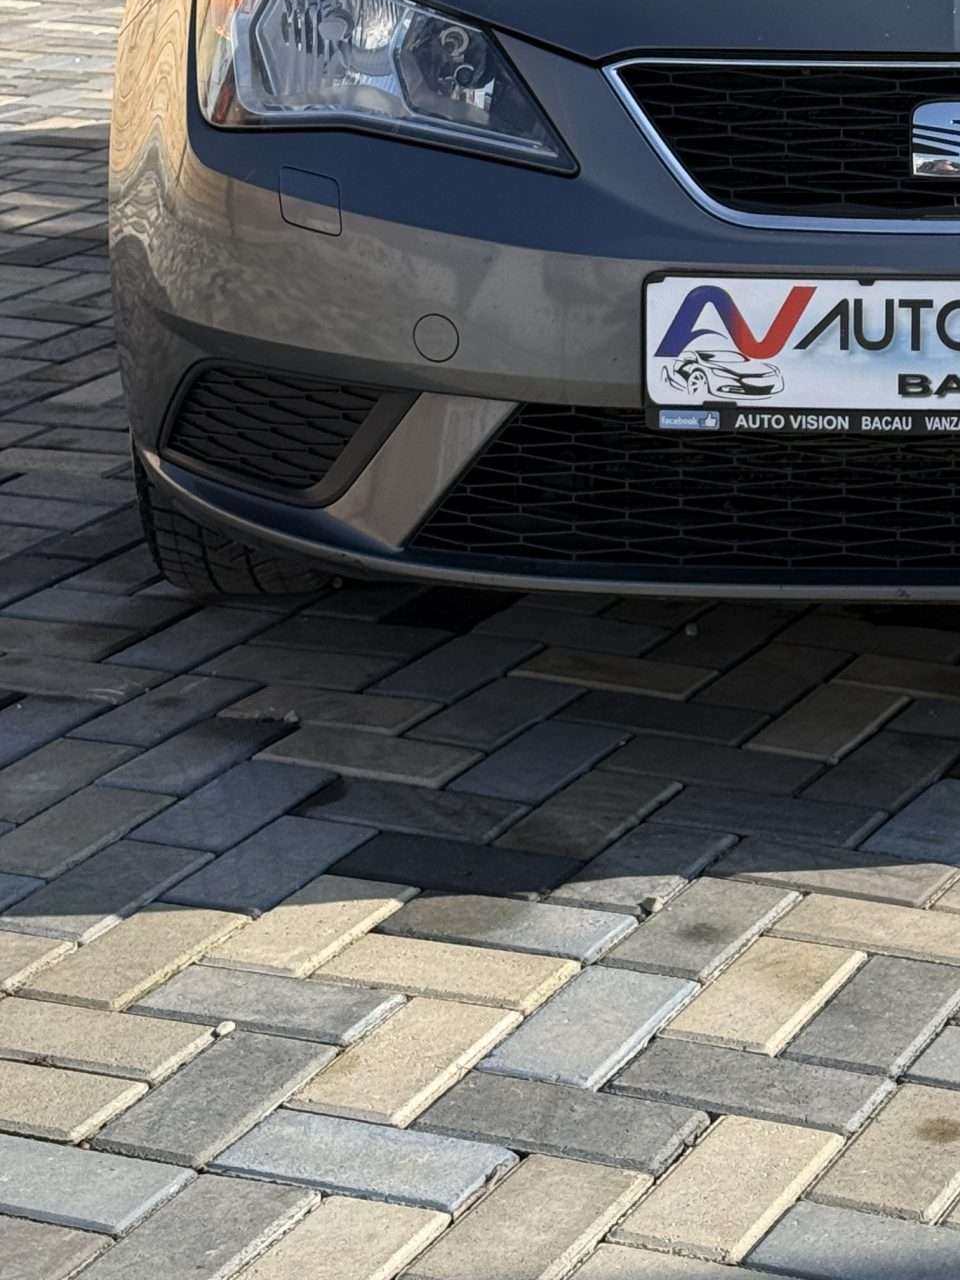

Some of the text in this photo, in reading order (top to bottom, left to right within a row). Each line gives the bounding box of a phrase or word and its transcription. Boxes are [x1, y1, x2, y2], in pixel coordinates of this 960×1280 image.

[735, 414, 785, 430] AUTO
[790, 415, 849, 430] VISION
[861, 416, 912, 431] BACAU
